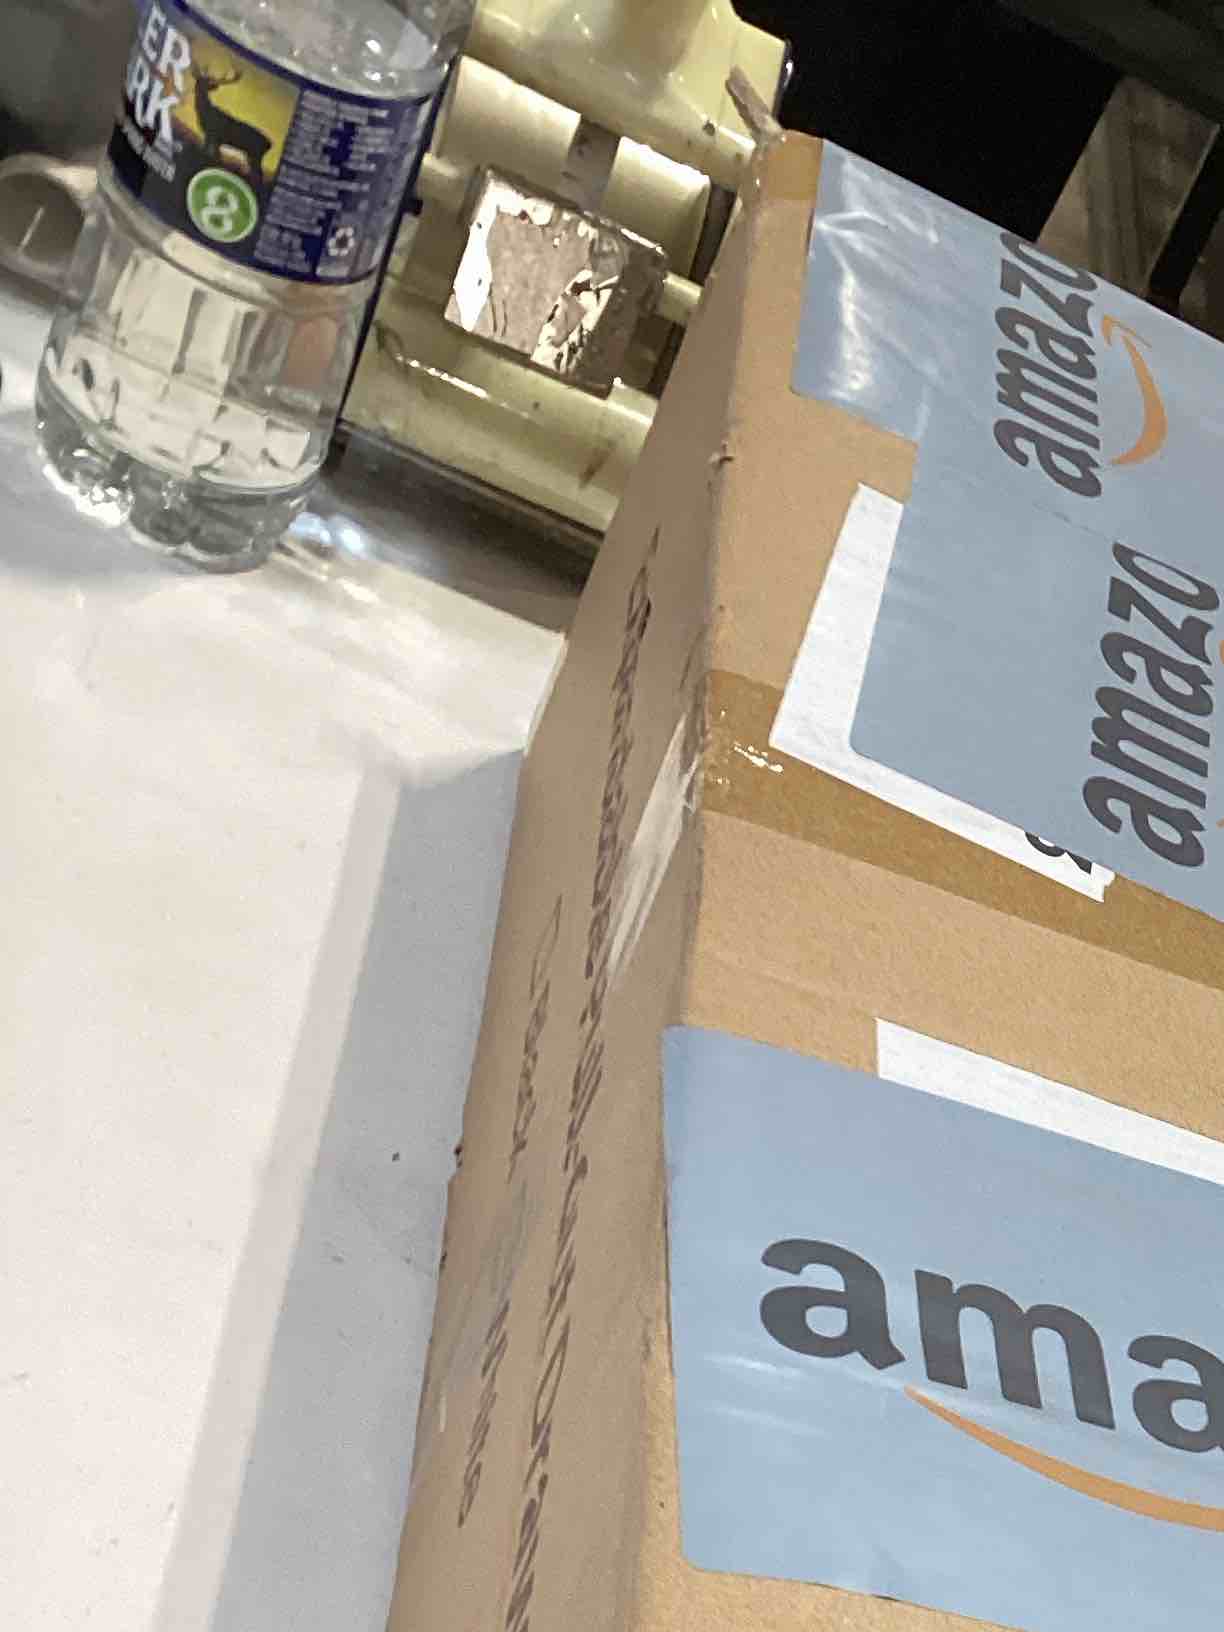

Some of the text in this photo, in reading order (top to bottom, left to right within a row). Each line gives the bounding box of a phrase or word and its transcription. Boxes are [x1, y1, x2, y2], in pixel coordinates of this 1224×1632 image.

[141, 2, 191, 93] ER
[993, 231, 1102, 499] amazo
[1083, 542, 1221, 868] amazo
